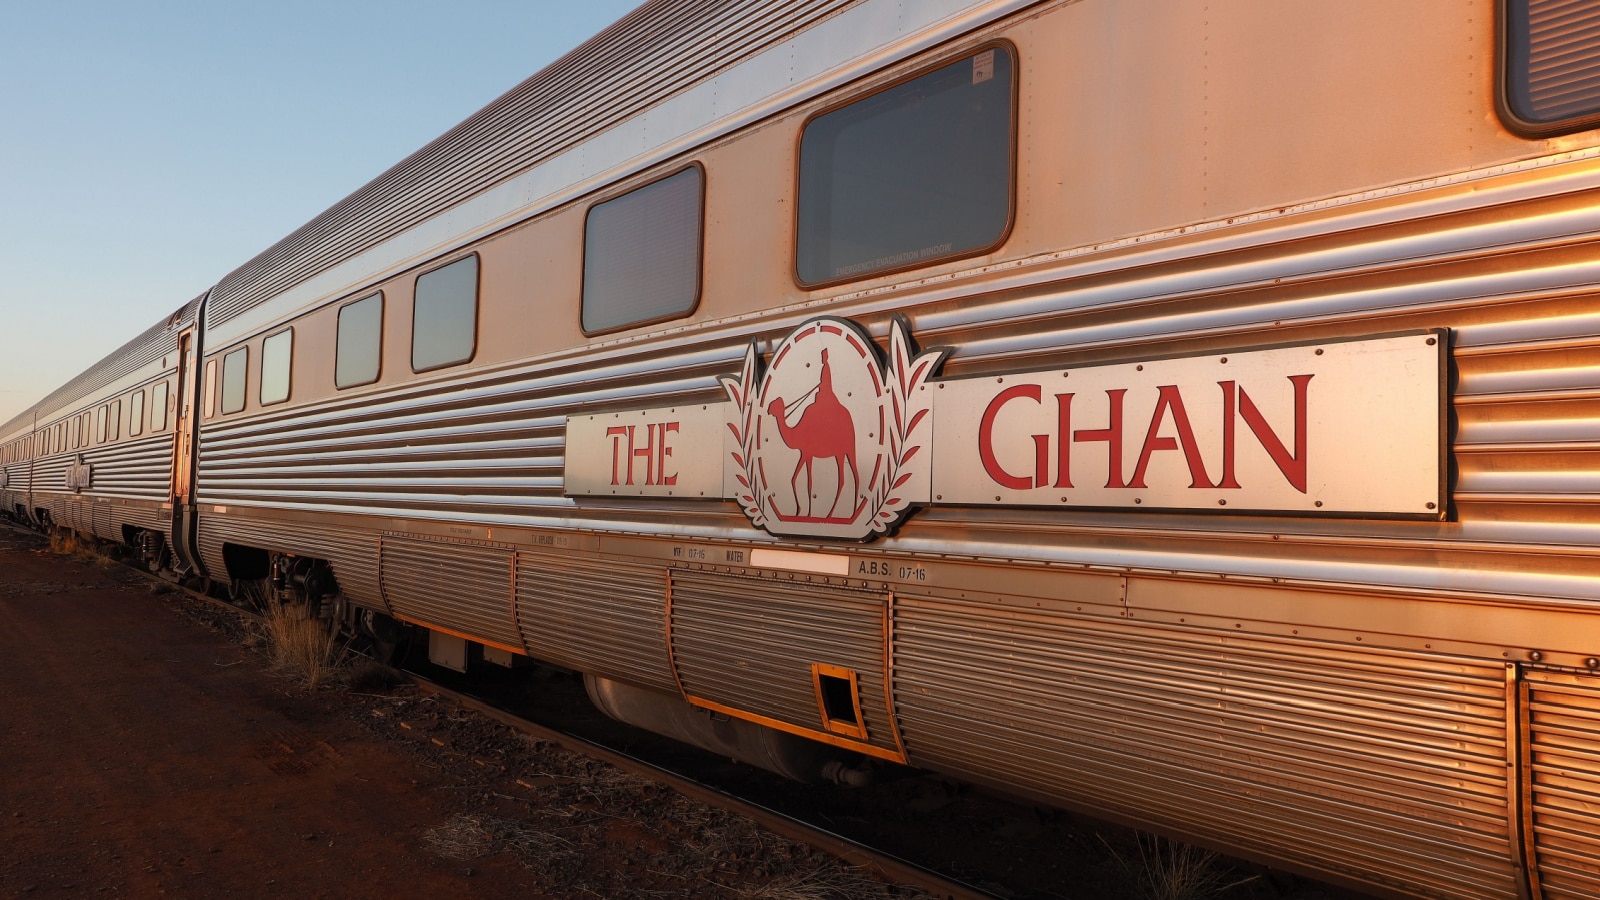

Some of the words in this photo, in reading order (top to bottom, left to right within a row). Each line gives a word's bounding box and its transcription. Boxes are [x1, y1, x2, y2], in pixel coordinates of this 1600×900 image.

[836, 259, 876, 276] EMERGENCY
[877, 250, 919, 267] EVACUATION
[920, 243, 952, 258] WINDOW
[605, 421, 680, 486] THE
[978, 373, 1315, 494] GHAN
[726, 550, 744, 563] WATER
[858, 560, 892, 576] A.B.S.
